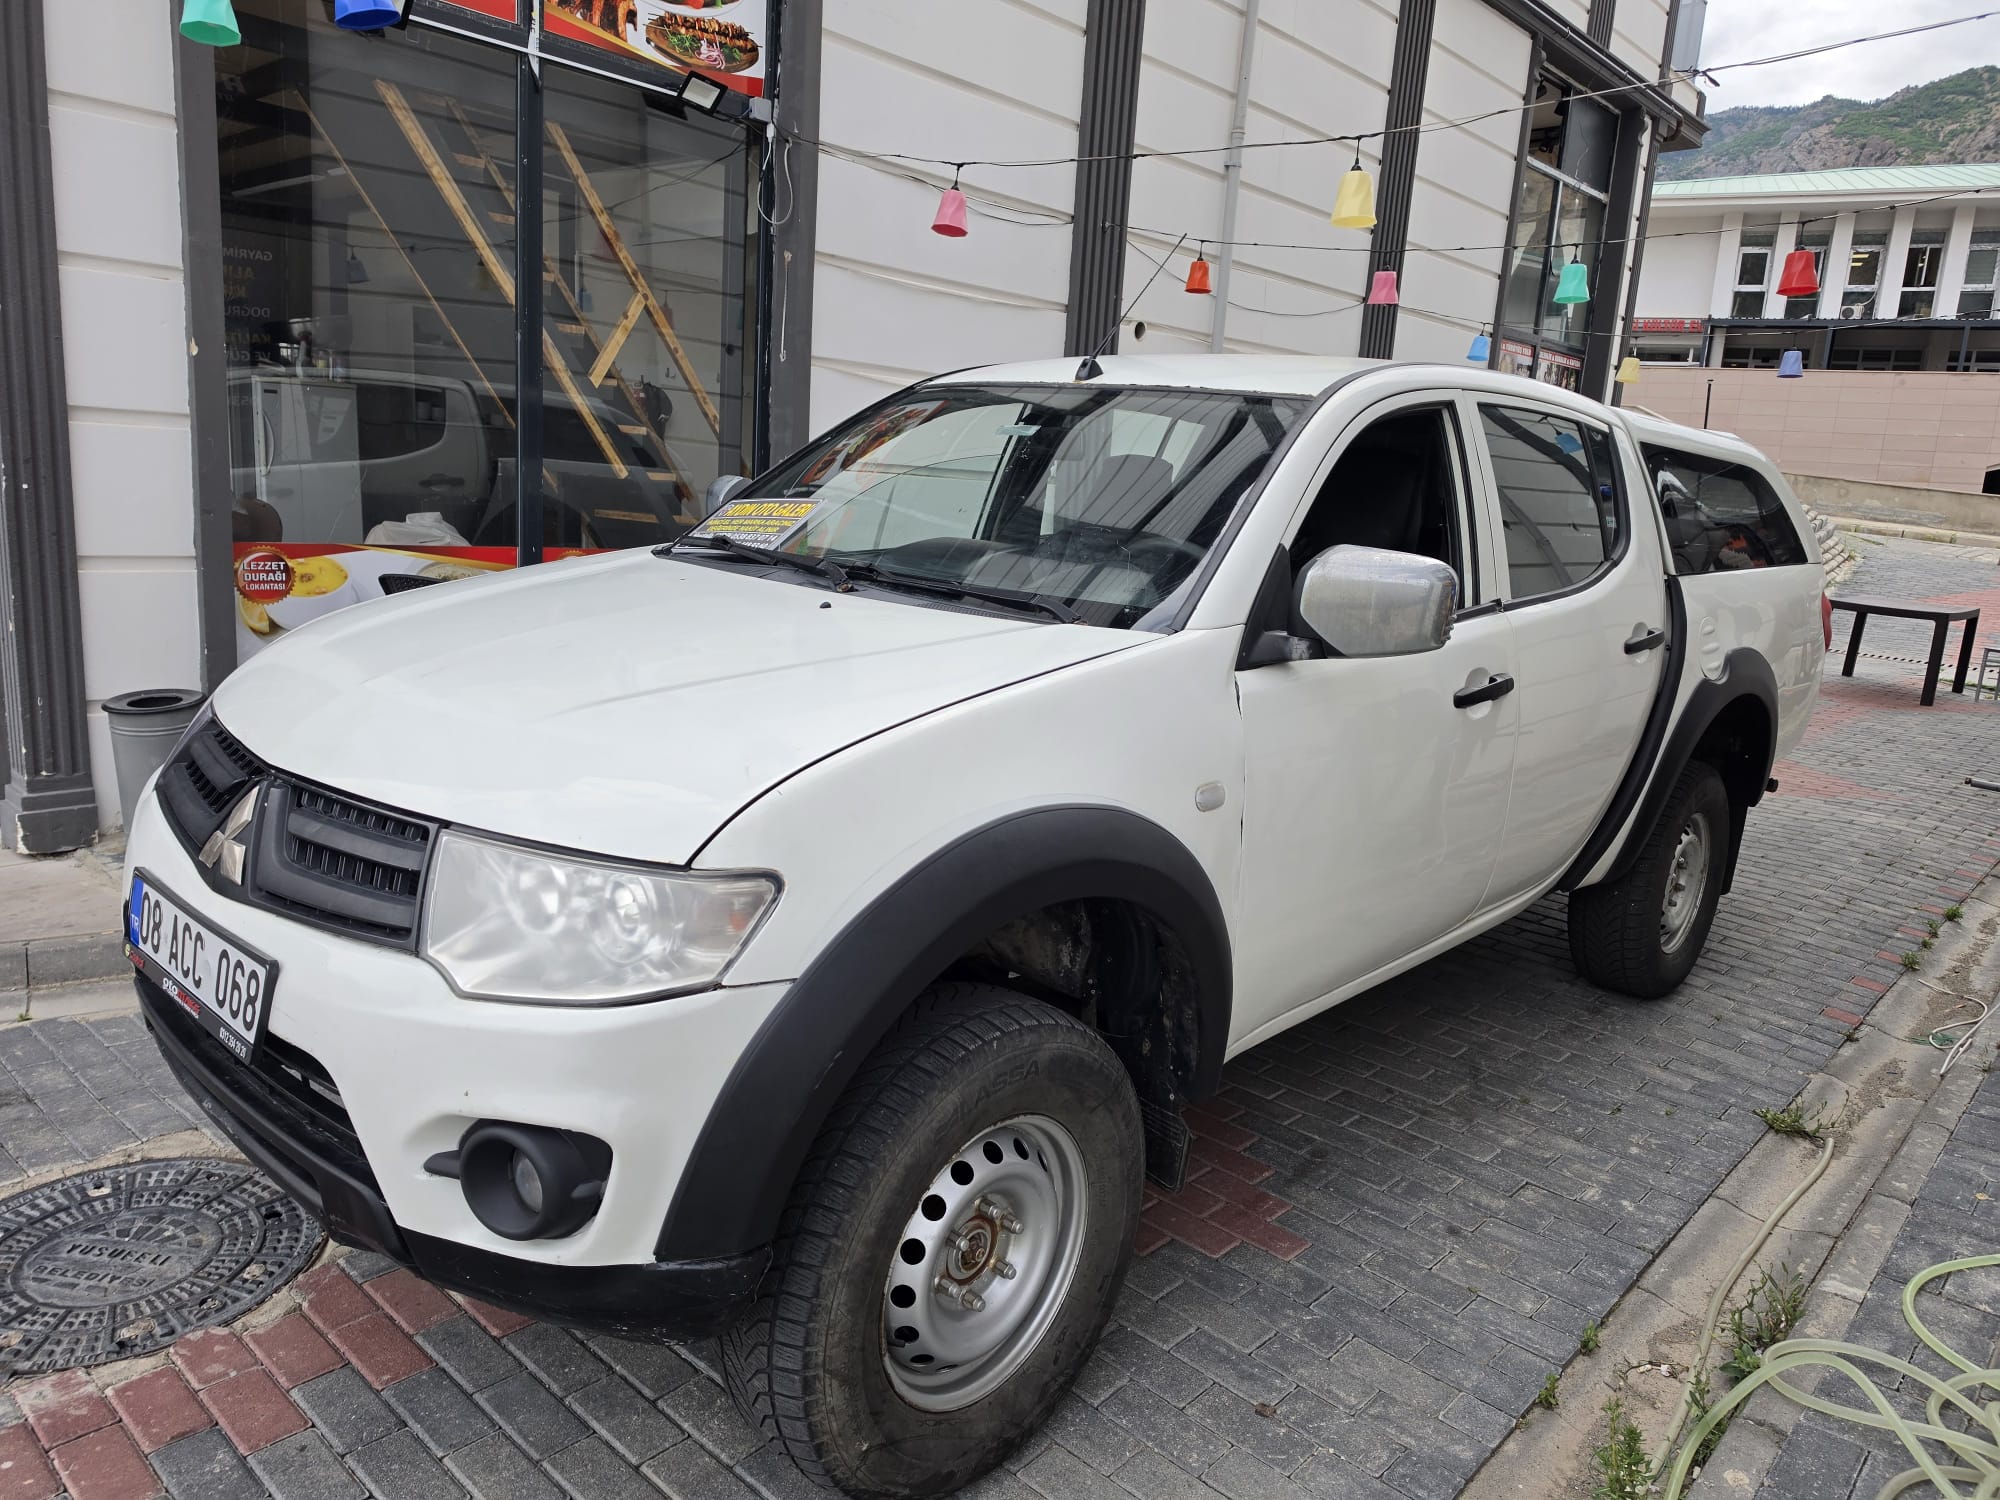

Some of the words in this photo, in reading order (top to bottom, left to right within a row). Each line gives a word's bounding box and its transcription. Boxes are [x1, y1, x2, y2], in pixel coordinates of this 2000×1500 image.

[243, 561, 285, 570] LEZZET
[244, 571, 286, 581] DURAĞI
[245, 583, 286, 591] LOKANTASI
[130, 912, 140, 932] TR
[139, 891, 162, 954] 08
[168, 913, 205, 989] ACC
[215, 949, 260, 1032] 068
